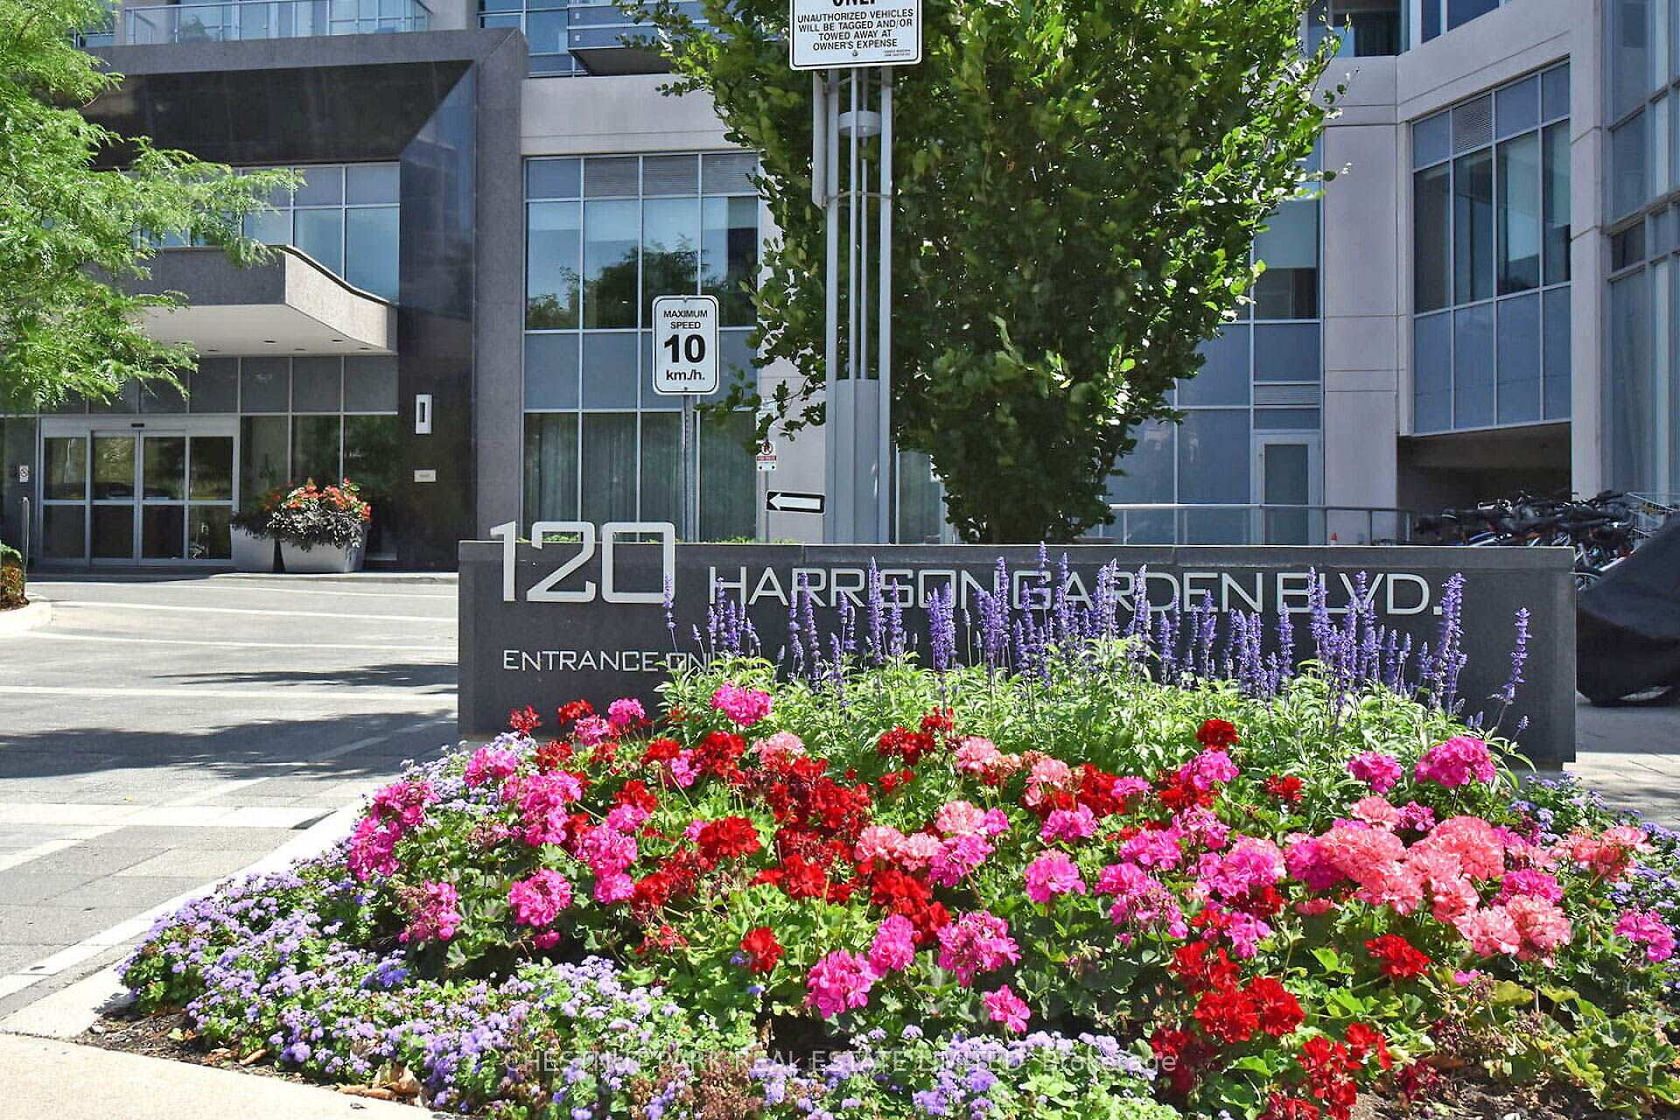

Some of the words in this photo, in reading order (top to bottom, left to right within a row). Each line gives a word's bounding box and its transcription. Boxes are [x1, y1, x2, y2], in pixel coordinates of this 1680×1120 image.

[797, 11, 867, 23] UNAUTHORIZED
[870, 8, 914, 19] VEHICLES
[798, 24, 820, 33] WILL
[823, 23, 835, 32] BE
[838, 21, 873, 31] TAGGED
[876, 18, 913, 28] AND/OR
[818, 31, 851, 41] TOWED
[853, 30, 879, 40] AWAY
[881, 29, 892, 38] AT
[812, 41, 854, 51] OWNER'S
[856, 39, 898, 49] EXPENSE
[663, 310, 708, 318] MAXIMUM
[670, 321, 701, 329] SPEED
[664, 334, 706, 363] 10
[490, 520, 676, 604] 120
[1012, 570, 1263, 614] GARDEN
[1276, 572, 1443, 615] BLVD.
[503, 650, 659, 672] ENTRANCE
